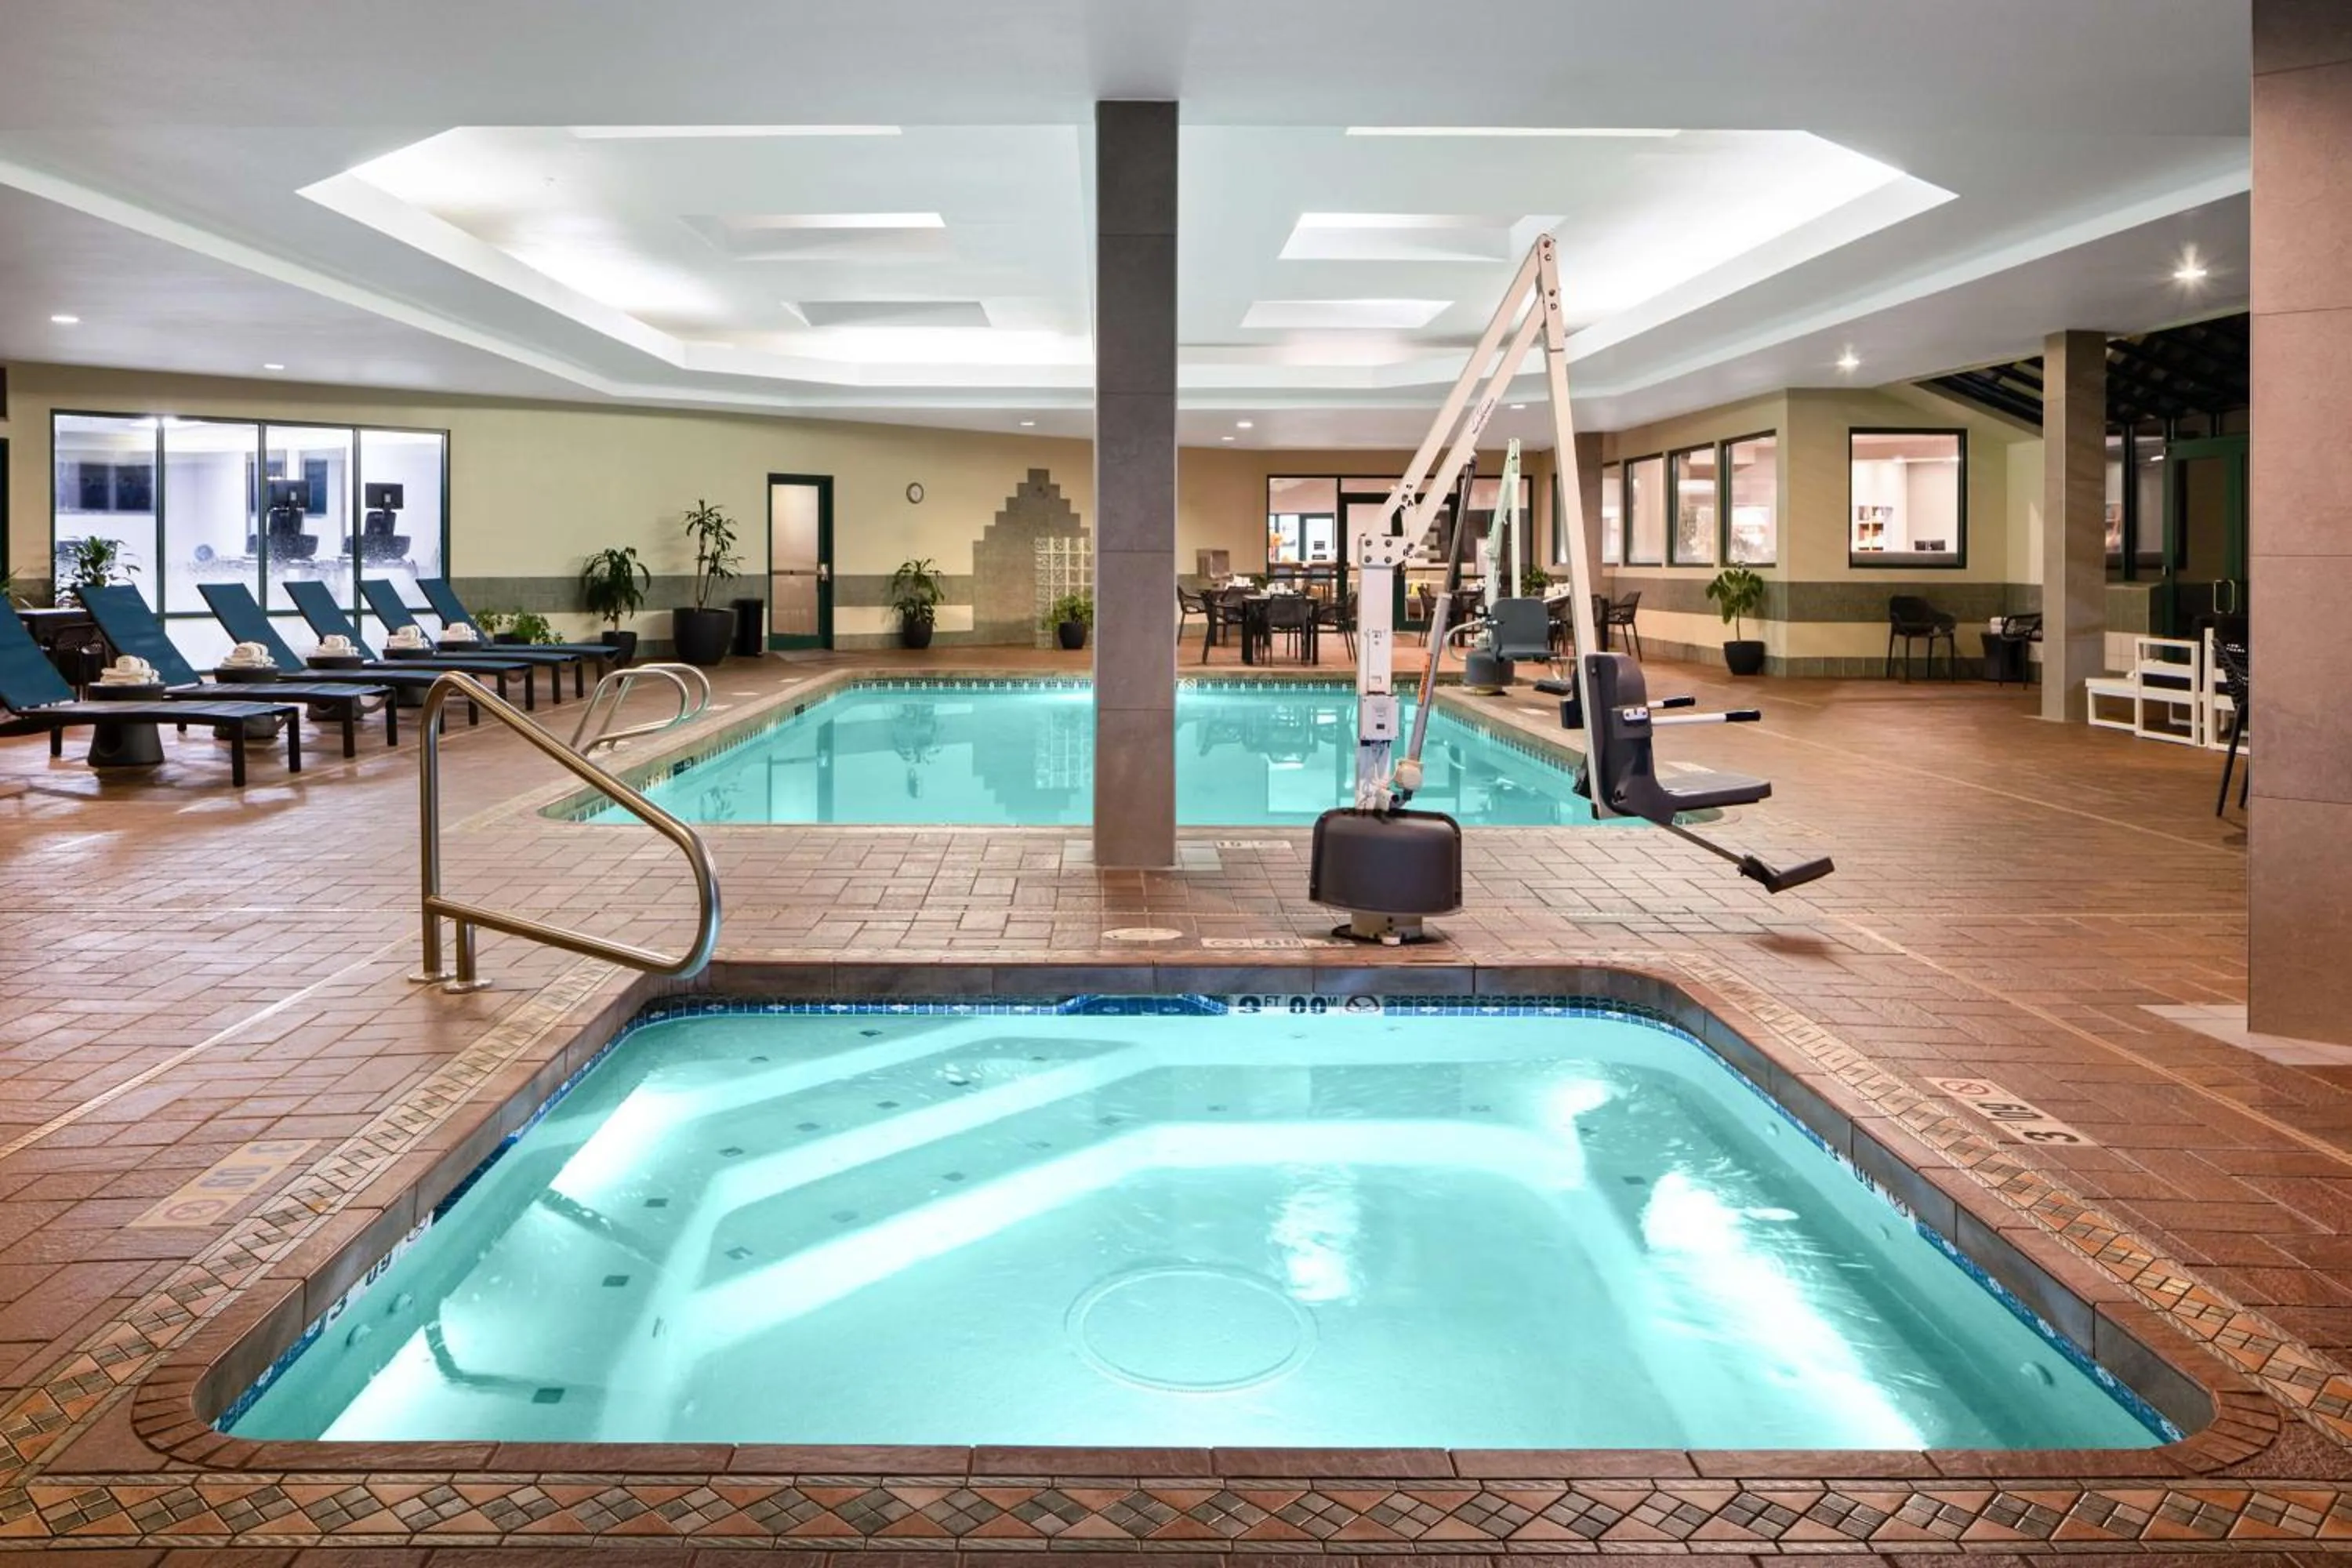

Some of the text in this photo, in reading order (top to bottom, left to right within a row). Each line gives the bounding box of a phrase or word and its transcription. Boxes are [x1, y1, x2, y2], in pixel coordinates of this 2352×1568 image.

[1264, 995, 1280, 1007] FT
[1976, 1103, 2080, 1142] 3 09
